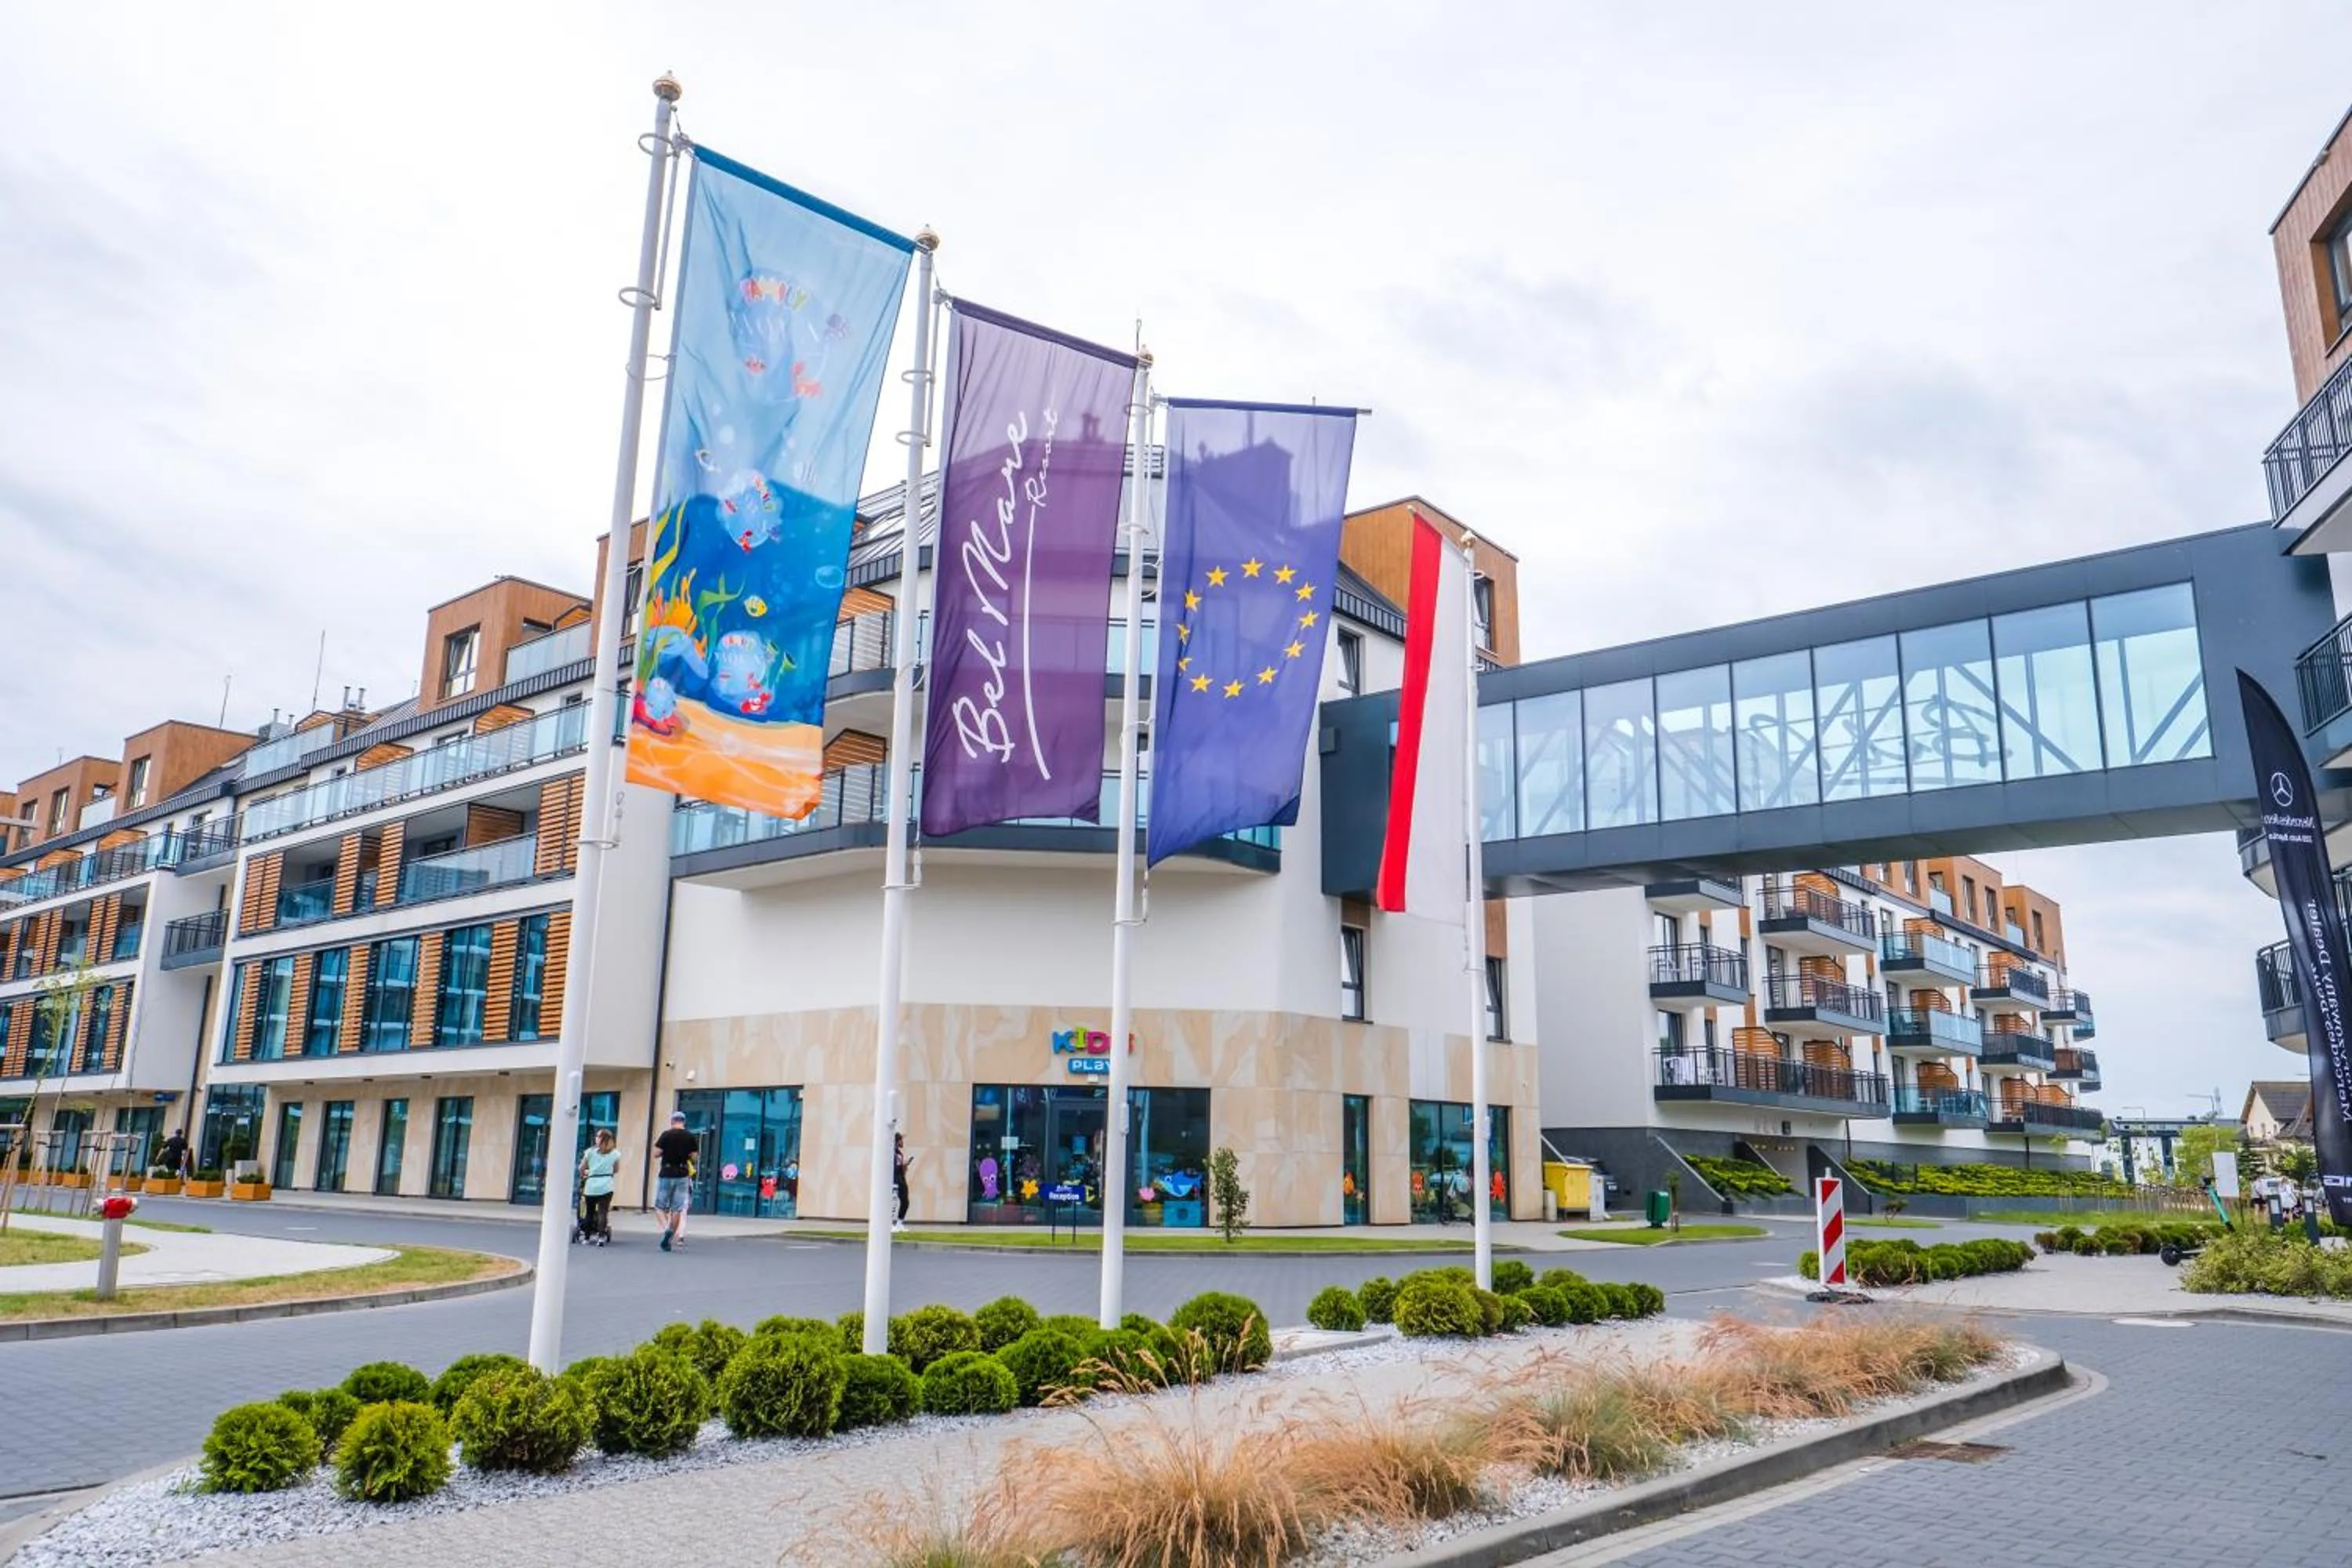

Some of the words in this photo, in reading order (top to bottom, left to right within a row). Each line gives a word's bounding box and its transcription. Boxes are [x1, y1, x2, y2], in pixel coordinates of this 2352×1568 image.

[962, 410, 1029, 626] Mare
[951, 628, 1016, 764] Bel
[1052, 1028, 1136, 1055] KID
